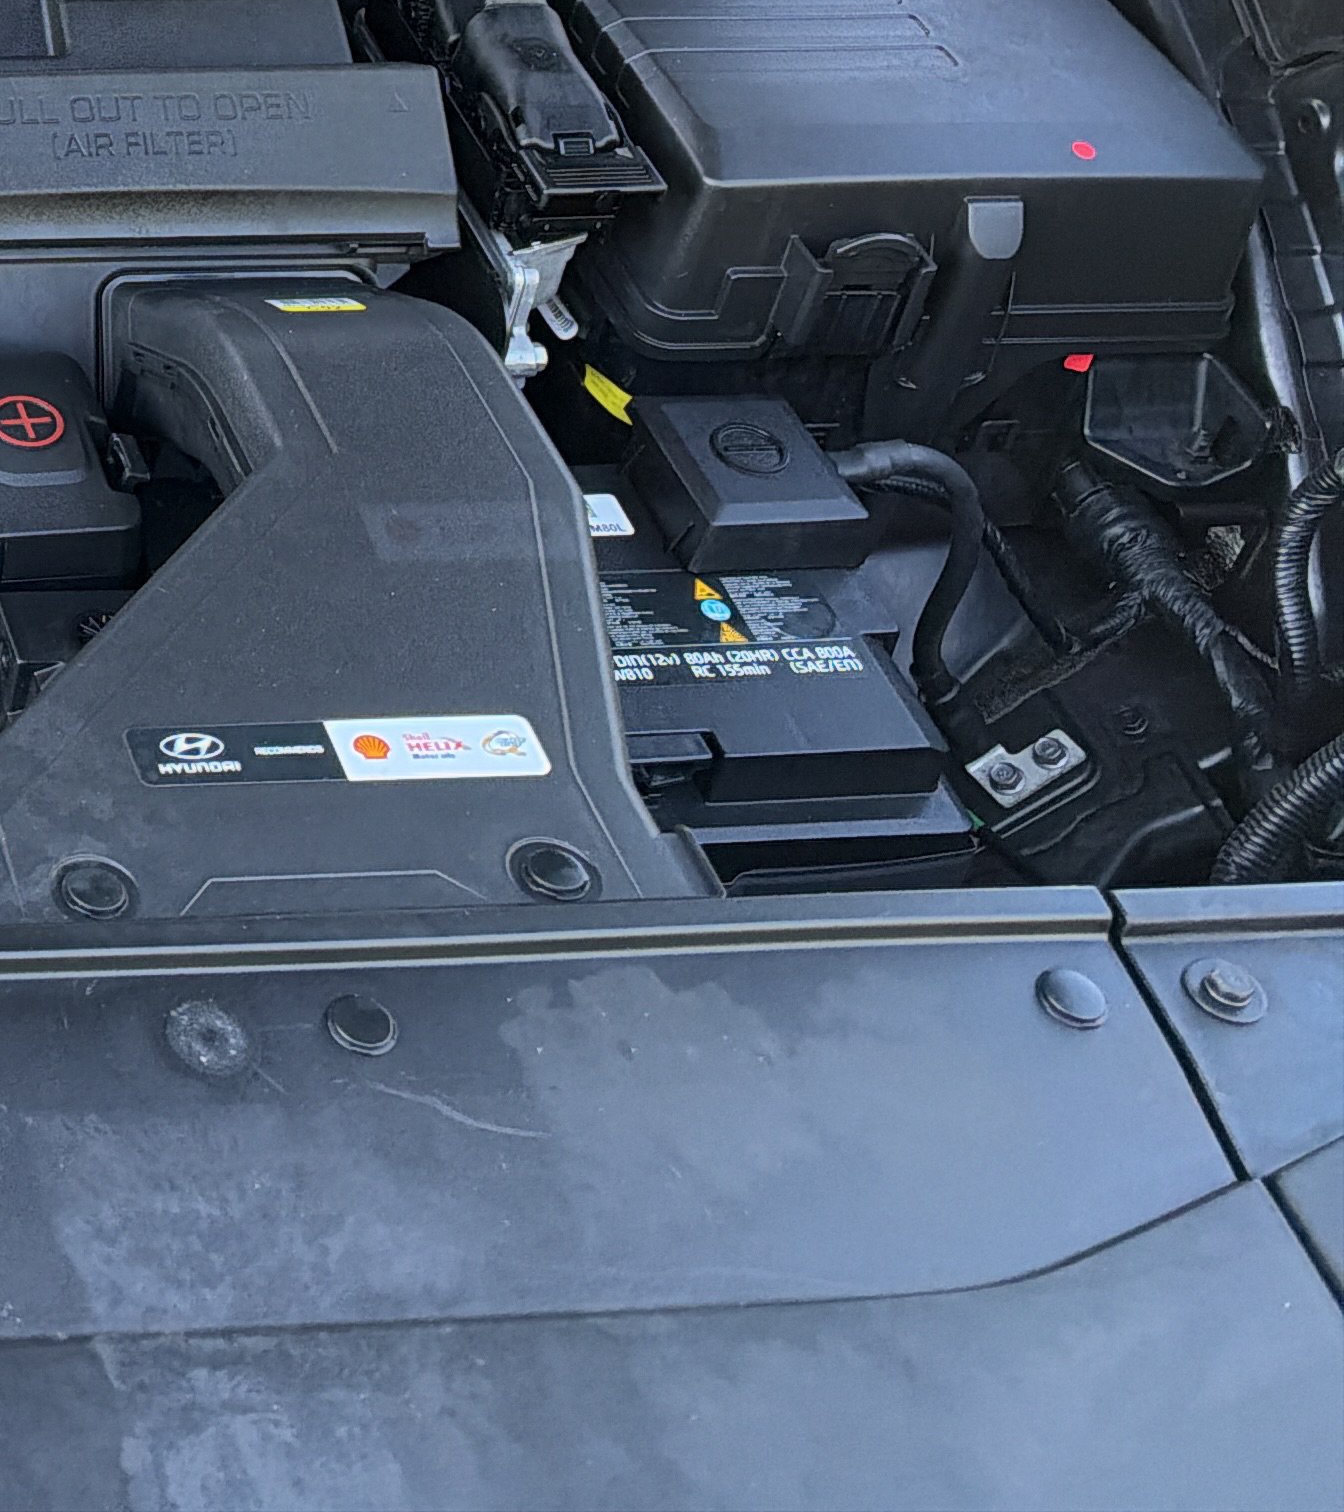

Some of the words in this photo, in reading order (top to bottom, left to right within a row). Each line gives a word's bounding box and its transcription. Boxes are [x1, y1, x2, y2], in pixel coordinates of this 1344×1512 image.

[70, 93, 143, 123] OUT
[153, 92, 202, 121] TO
[213, 91, 313, 121] OPEN
[682, 651, 725, 666] 80Ah
[726, 648, 779, 664] (20HR)
[780, 647, 814, 662] CCA
[814, 645, 857, 660] 800A
[691, 664, 717, 679] RC
[718, 662, 773, 678] 155min
[406, 740, 464, 752] HELIX
[157, 760, 243, 776] HYUNDAI
